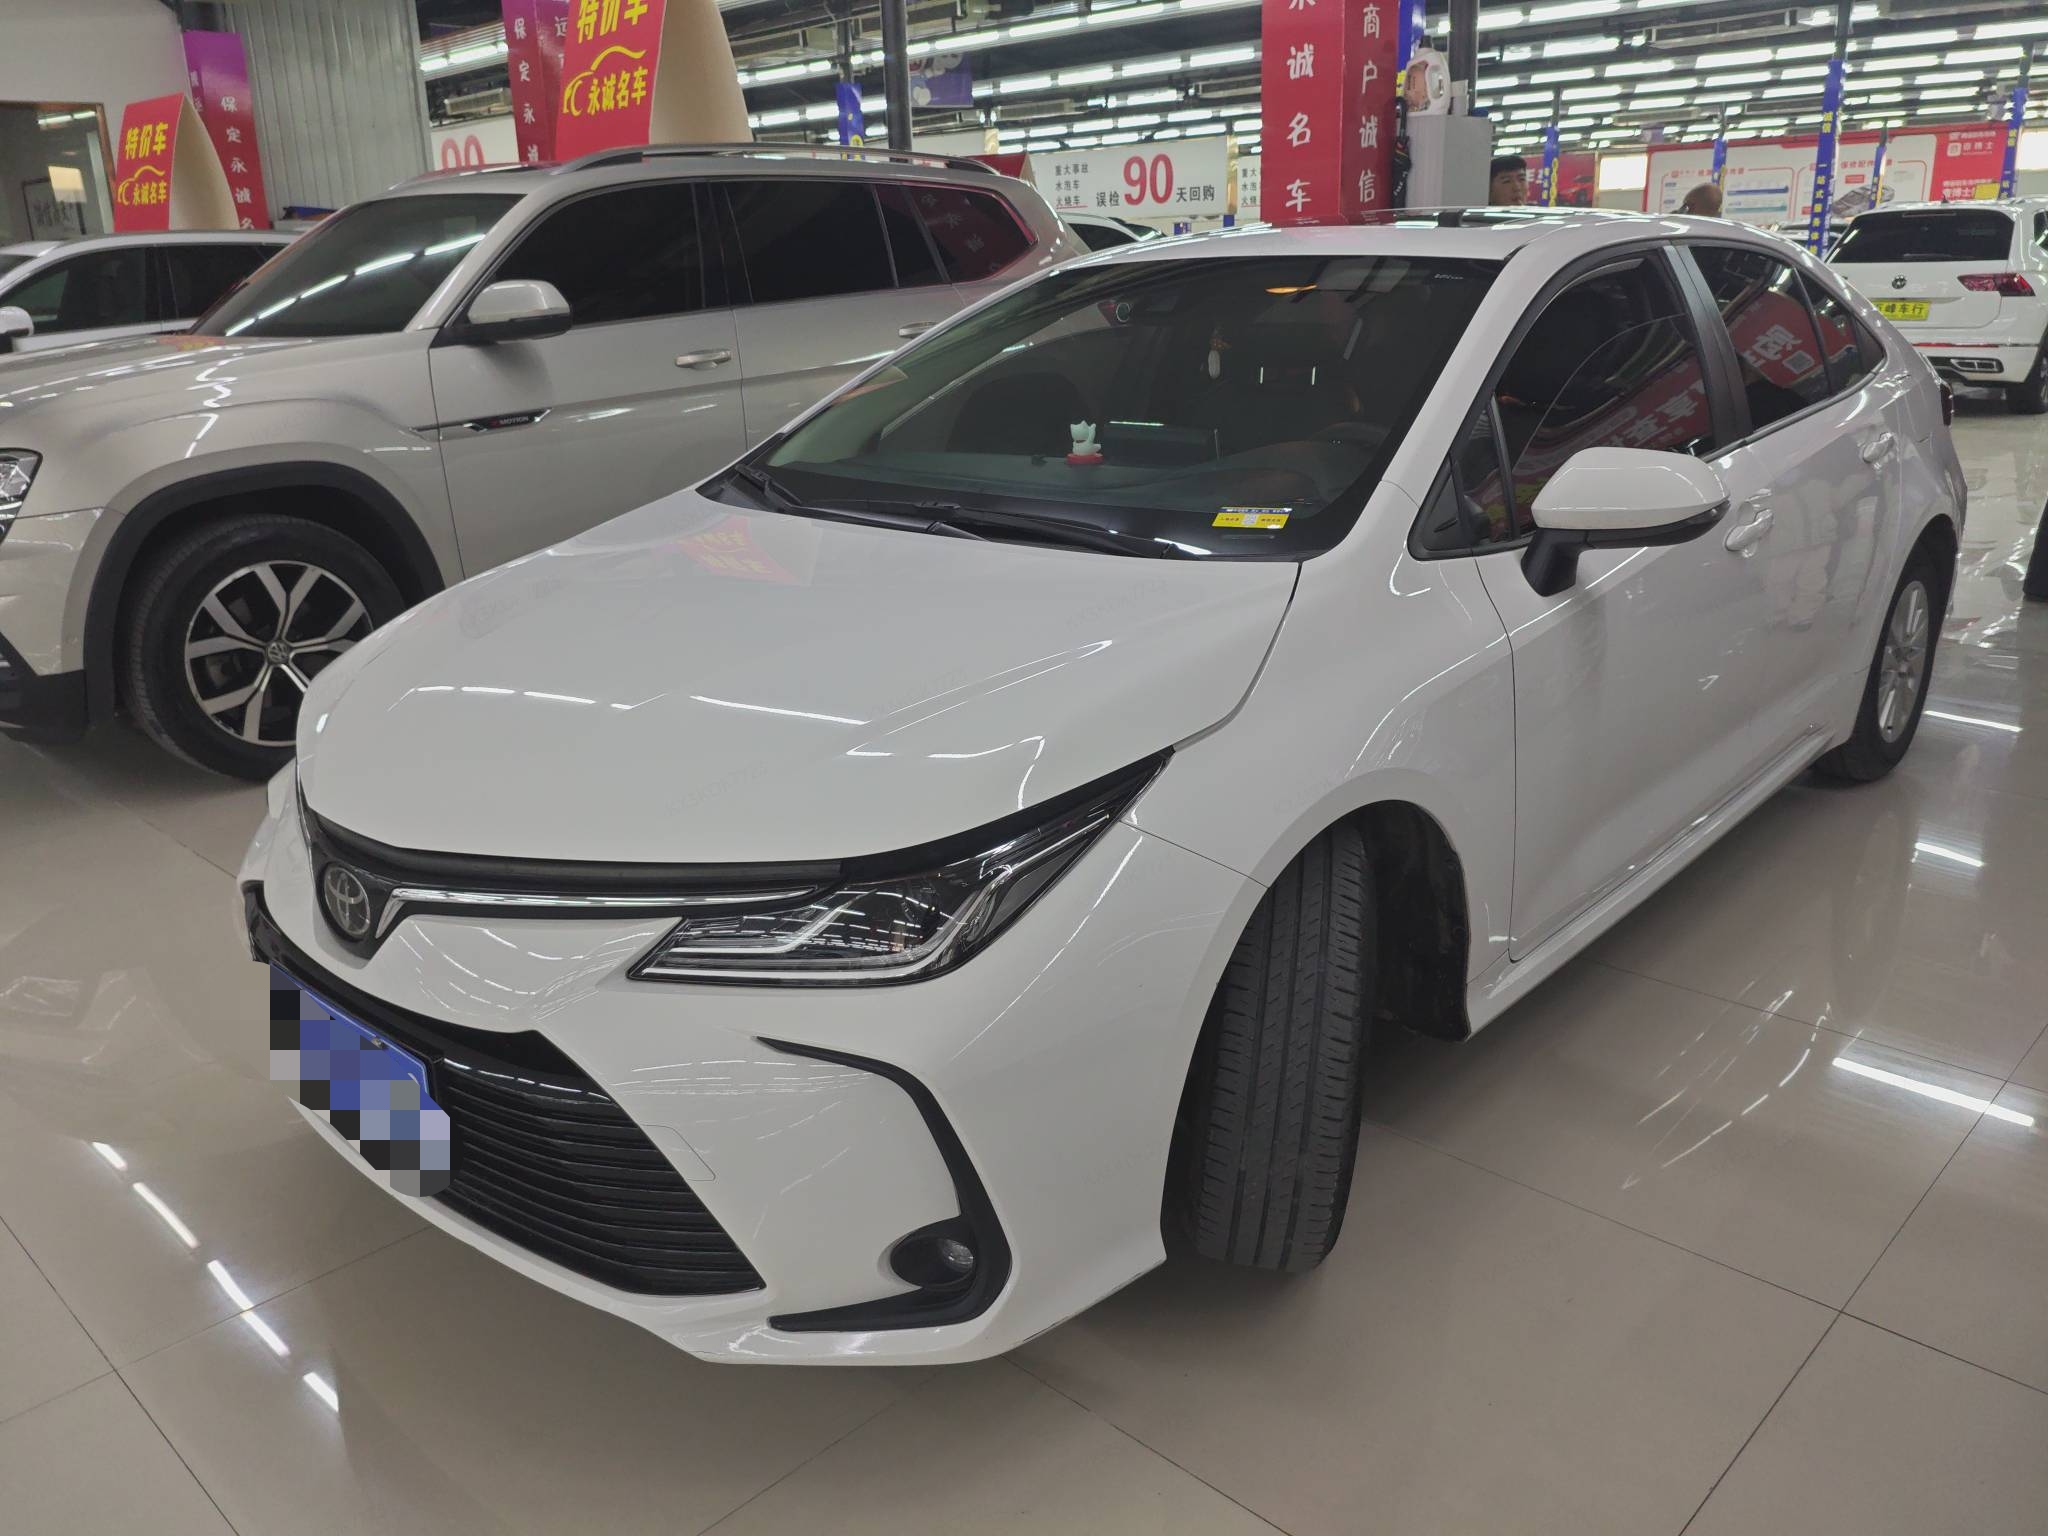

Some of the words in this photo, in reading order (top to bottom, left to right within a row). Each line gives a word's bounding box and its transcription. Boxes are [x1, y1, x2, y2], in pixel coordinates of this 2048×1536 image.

[587, 66, 648, 116] 永诚名车
[1286, 0, 1317, 212] 诚名车
[1359, 3, 1380, 203] 商户诚信
[125, 122, 169, 160] 特价车
[132, 180, 168, 207] 永诚名车
